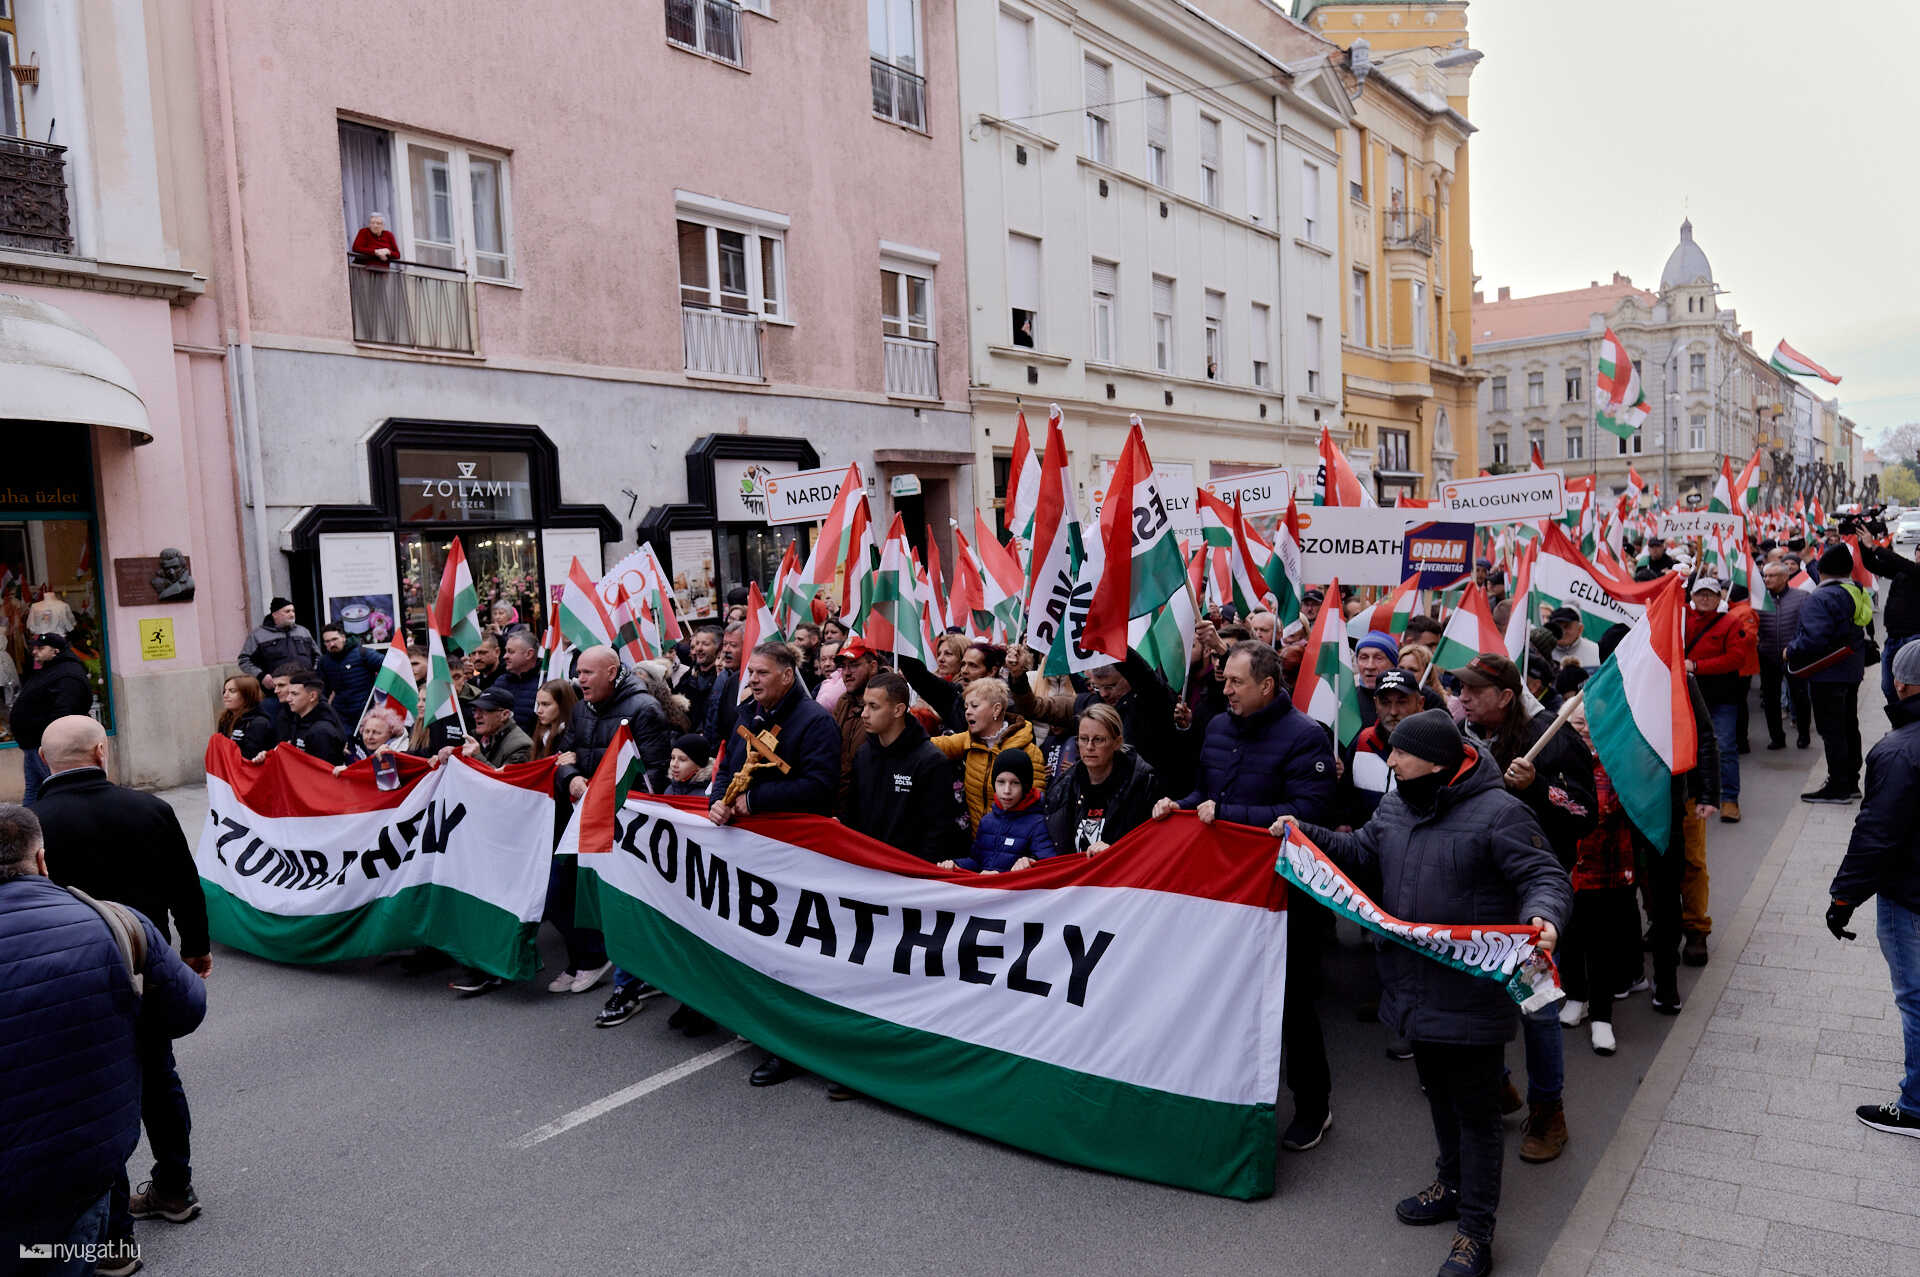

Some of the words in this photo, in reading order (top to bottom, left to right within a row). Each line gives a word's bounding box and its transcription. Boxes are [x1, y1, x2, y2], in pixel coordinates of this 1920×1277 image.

[36, 488, 80, 504] üzlet
[422, 480, 511, 496] ZOLAMI
[1452, 489, 1553, 510] BALOGUNYOM
[1412, 540, 1464, 560] ORBÁN
